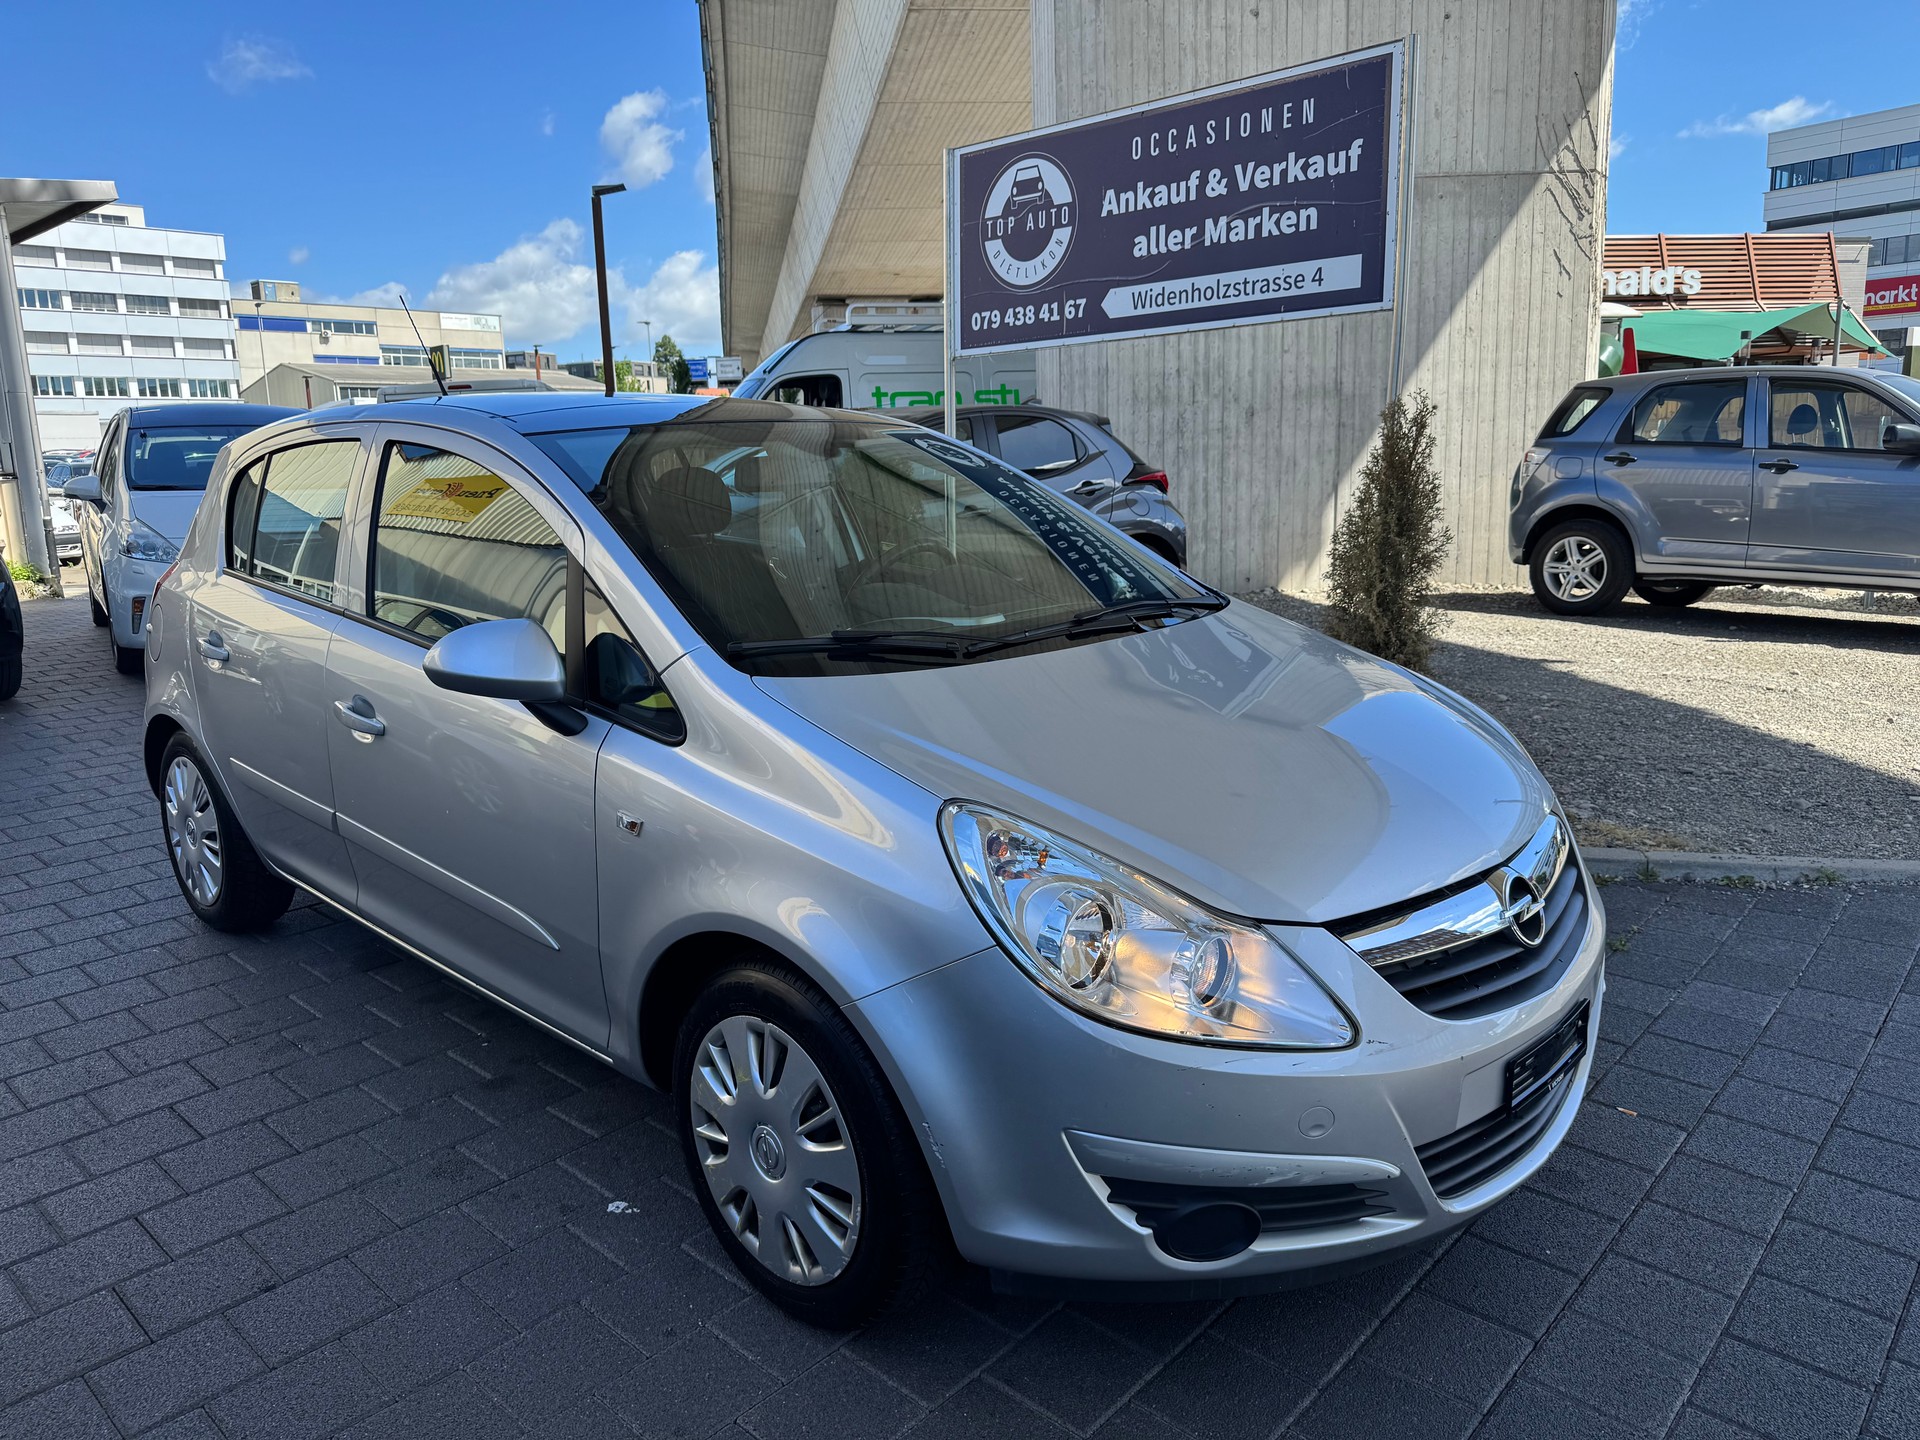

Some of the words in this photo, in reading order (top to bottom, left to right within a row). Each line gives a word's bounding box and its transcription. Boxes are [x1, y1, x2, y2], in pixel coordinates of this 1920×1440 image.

[1132, 98, 1315, 160] OCCASIONEN
[1100, 170, 1200, 218] Ankauf
[1205, 168, 1228, 198] &
[1234, 138, 1364, 192] Verkauf
[986, 216, 1015, 238] TOP
[1026, 206, 1069, 231] AUTO
[1132, 224, 1197, 258] aller
[1204, 206, 1318, 247] Marken
[993, 238, 1064, 278] DIETLIKON
[1131, 270, 1306, 311] Widenholzstrasse
[1311, 266, 1325, 287] 4
[971, 306, 1001, 331] 079
[1004, 302, 1035, 326] 438
[1038, 300, 1060, 322] 41
[1065, 298, 1087, 319] 67
